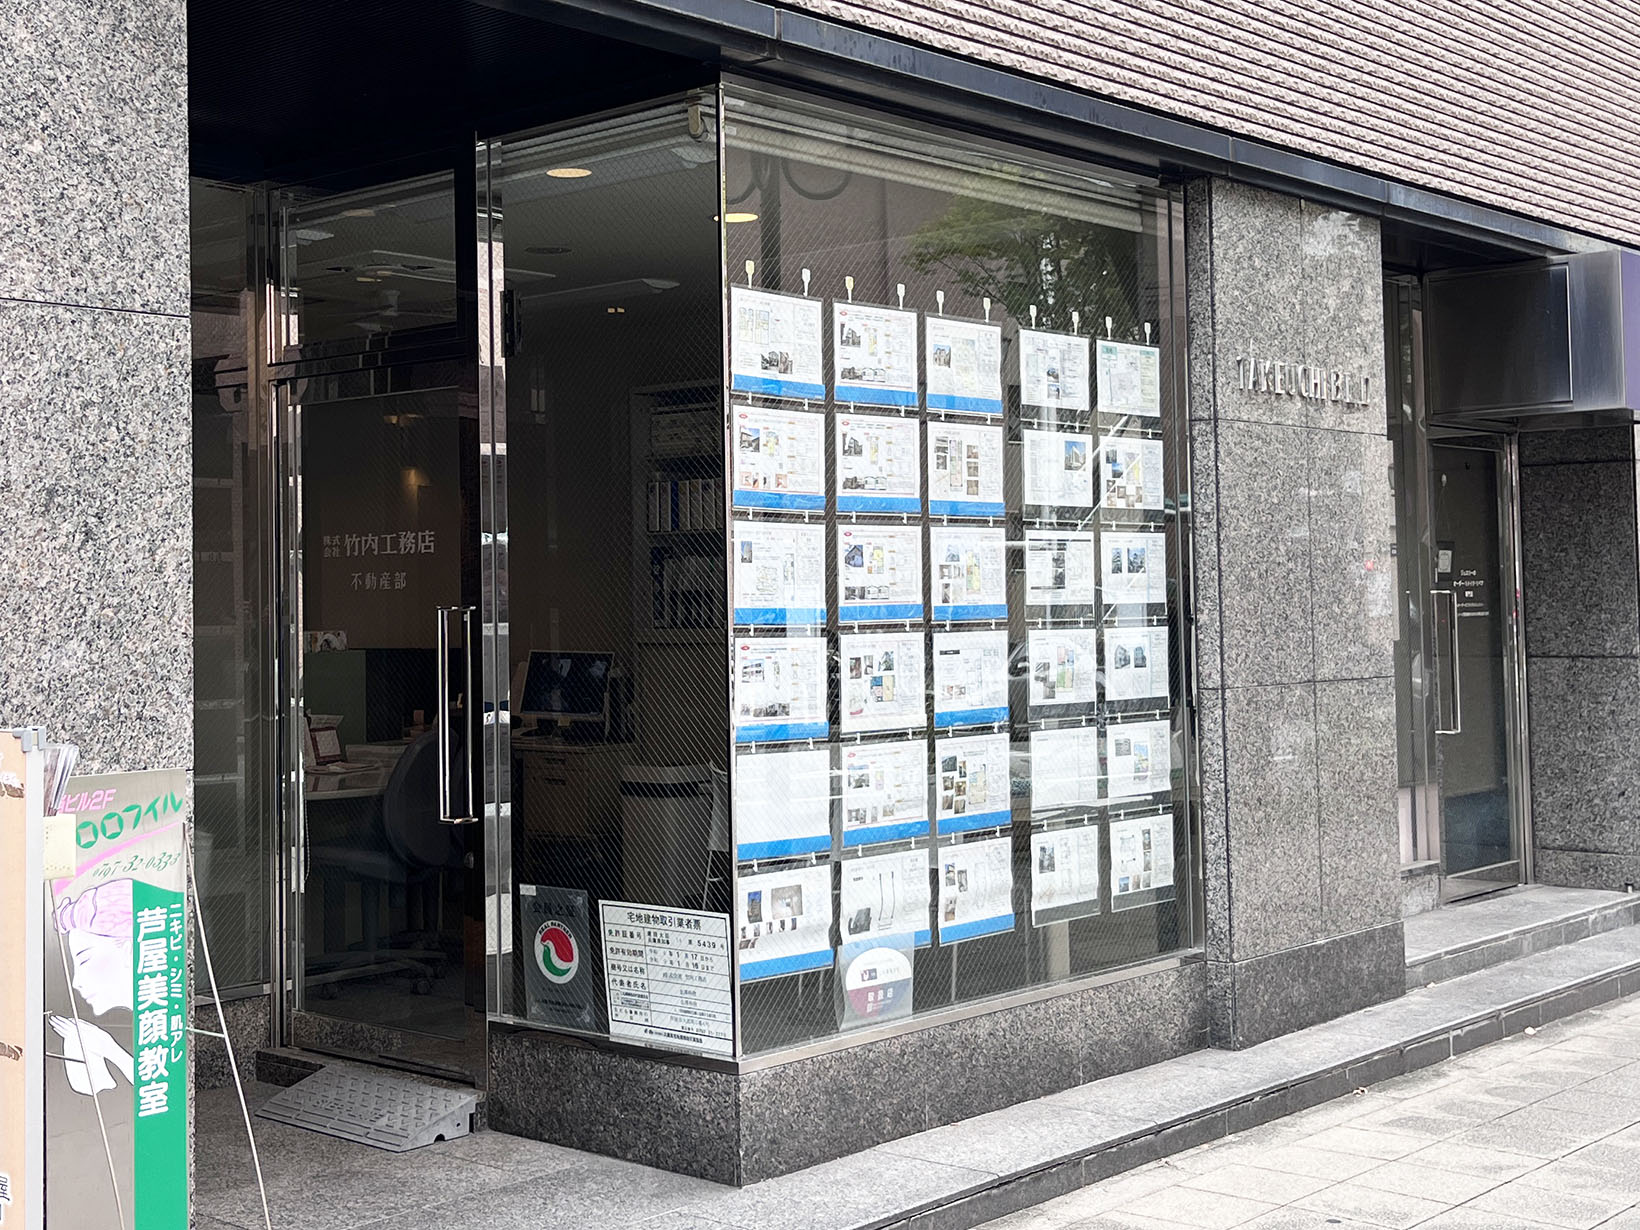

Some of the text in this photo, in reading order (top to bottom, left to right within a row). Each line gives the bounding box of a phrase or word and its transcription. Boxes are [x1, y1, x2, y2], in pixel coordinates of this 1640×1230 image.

[344, 530, 435, 557] 竹内工務店
[351, 571, 407, 591] 不動産部
[627, 912, 702, 931] 宅地建物取引業者票
[697, 940, 716, 948] 5439
[136, 906, 169, 1117] 芦屋美顔教室
